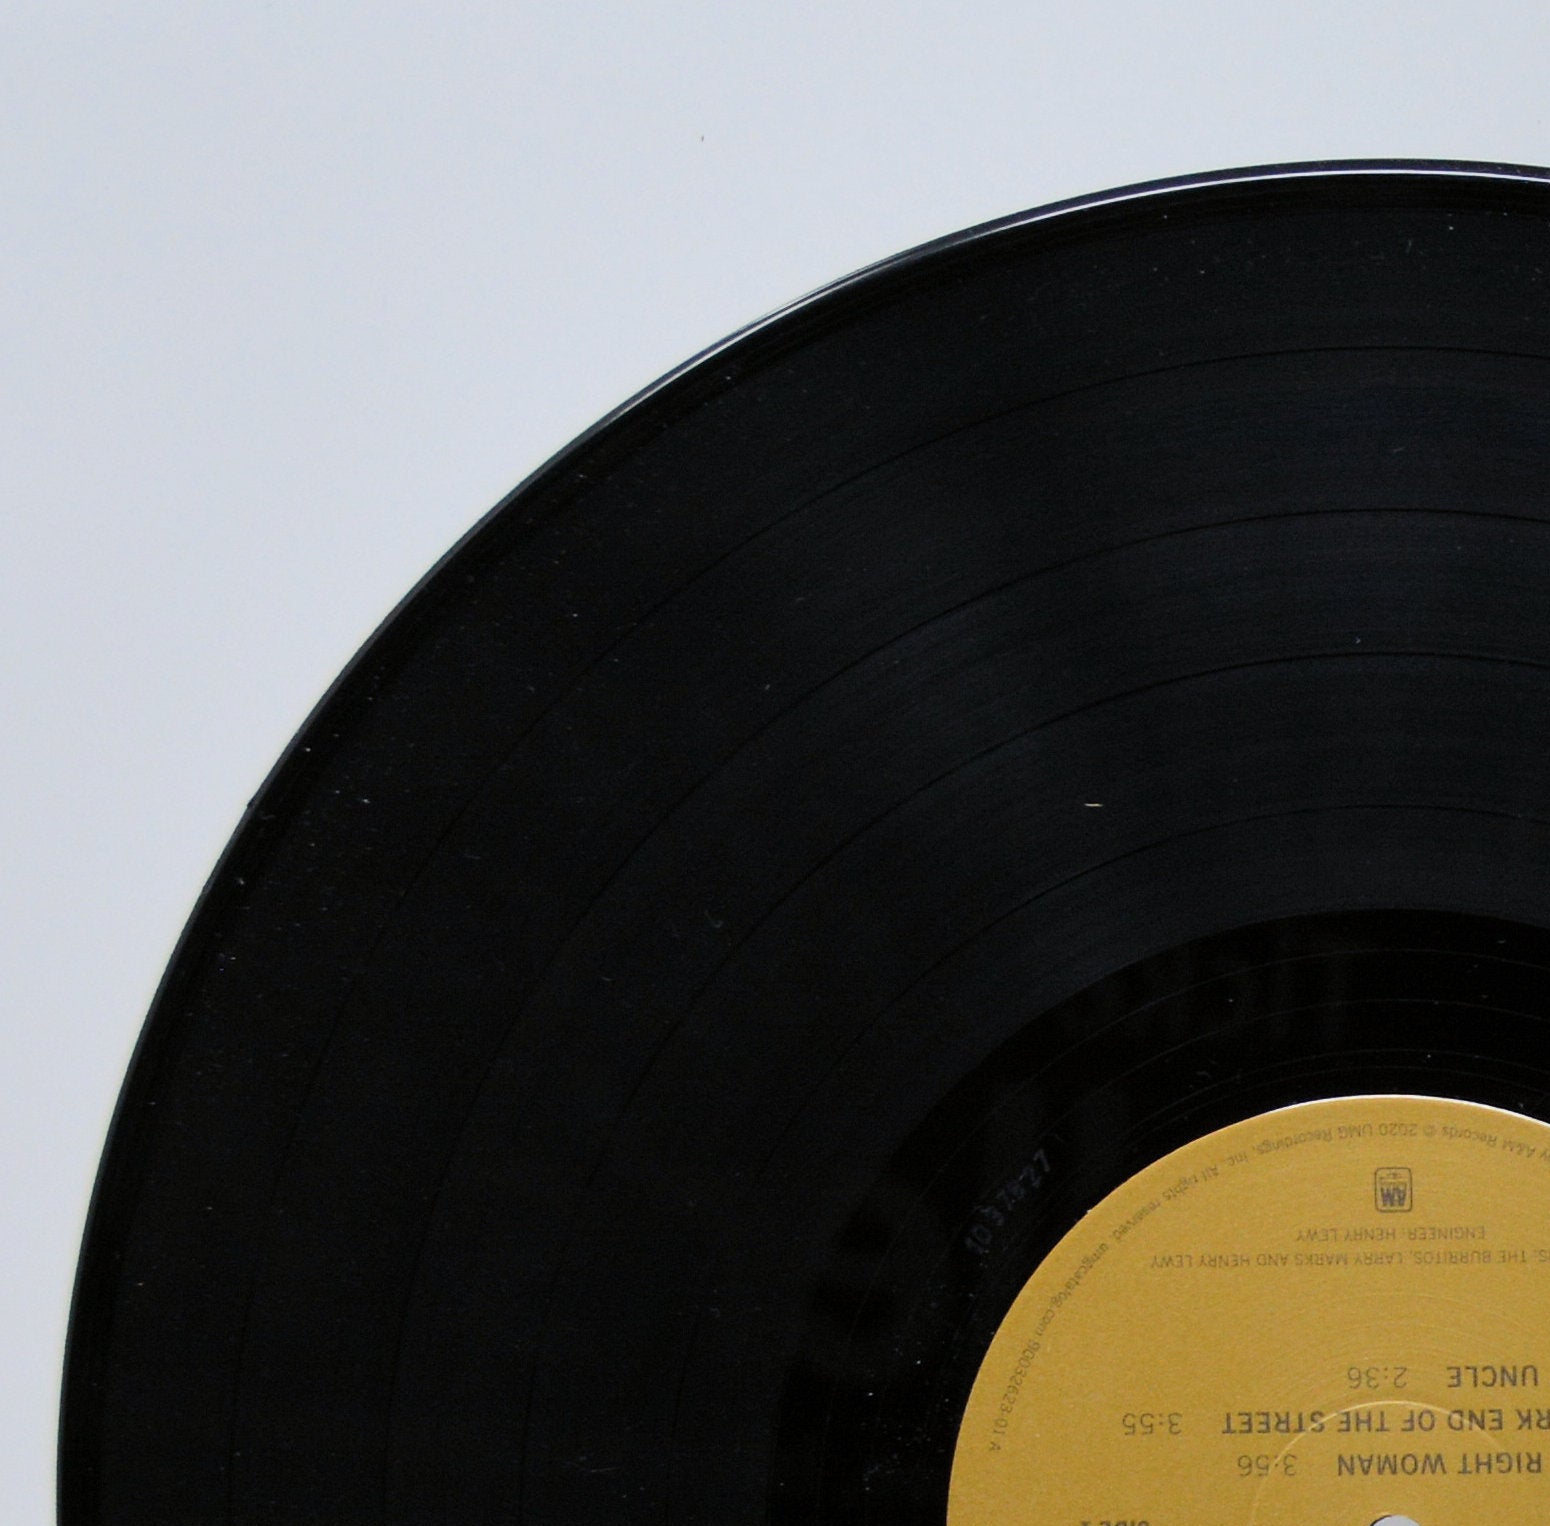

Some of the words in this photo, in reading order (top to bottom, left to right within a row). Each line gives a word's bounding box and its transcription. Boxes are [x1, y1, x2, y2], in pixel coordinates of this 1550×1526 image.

[1344, 1365, 1410, 1391] 2:36
[1445, 1363, 1539, 1389] UNCLE
[1120, 1411, 1183, 1438] 3:55
[1220, 1410, 1327, 1436] STREET
[1336, 1408, 1390, 1434] THE
[1400, 1408, 1437, 1433] OF
[1445, 1408, 1505, 1432] END
[1236, 1451, 1299, 1479] 3:56
[1336, 1452, 1448, 1477] WOMAN
[1456, 1451, 1543, 1476] RIGHT
